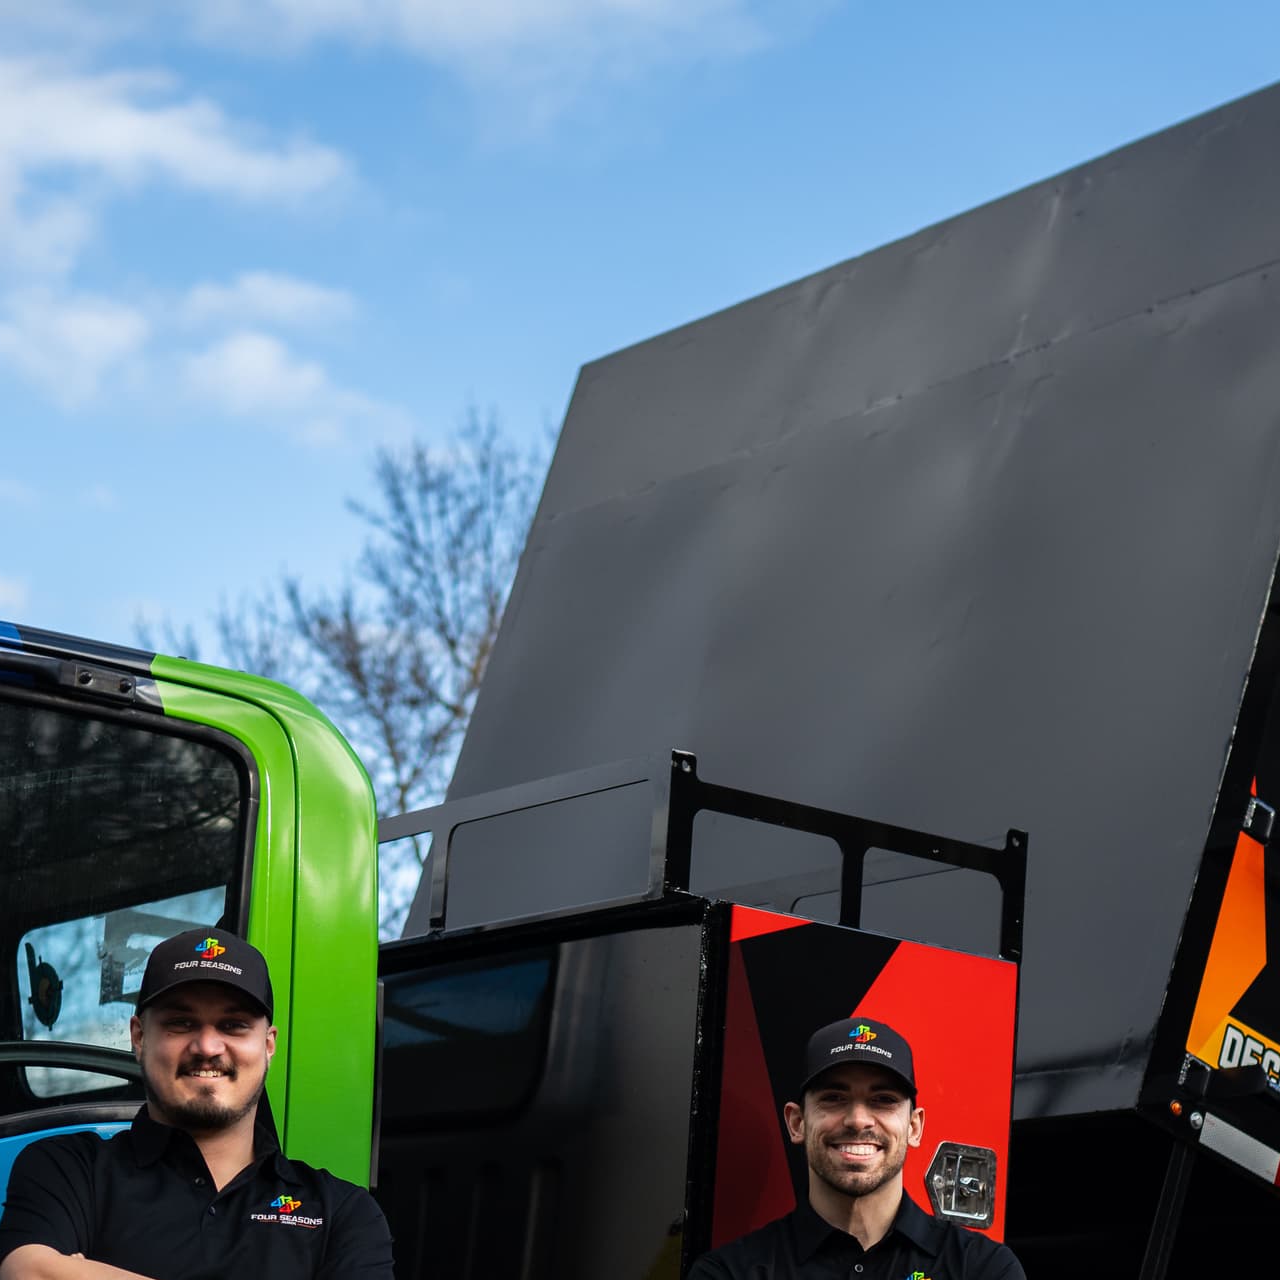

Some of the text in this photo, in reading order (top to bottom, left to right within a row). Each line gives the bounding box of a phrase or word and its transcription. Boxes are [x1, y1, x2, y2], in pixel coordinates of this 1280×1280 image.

[174, 960, 243, 975] FOUR SEASONS
[830, 1043, 893, 1059] FOUR SEASONS
[279, 1214, 323, 1225] SEASONS
